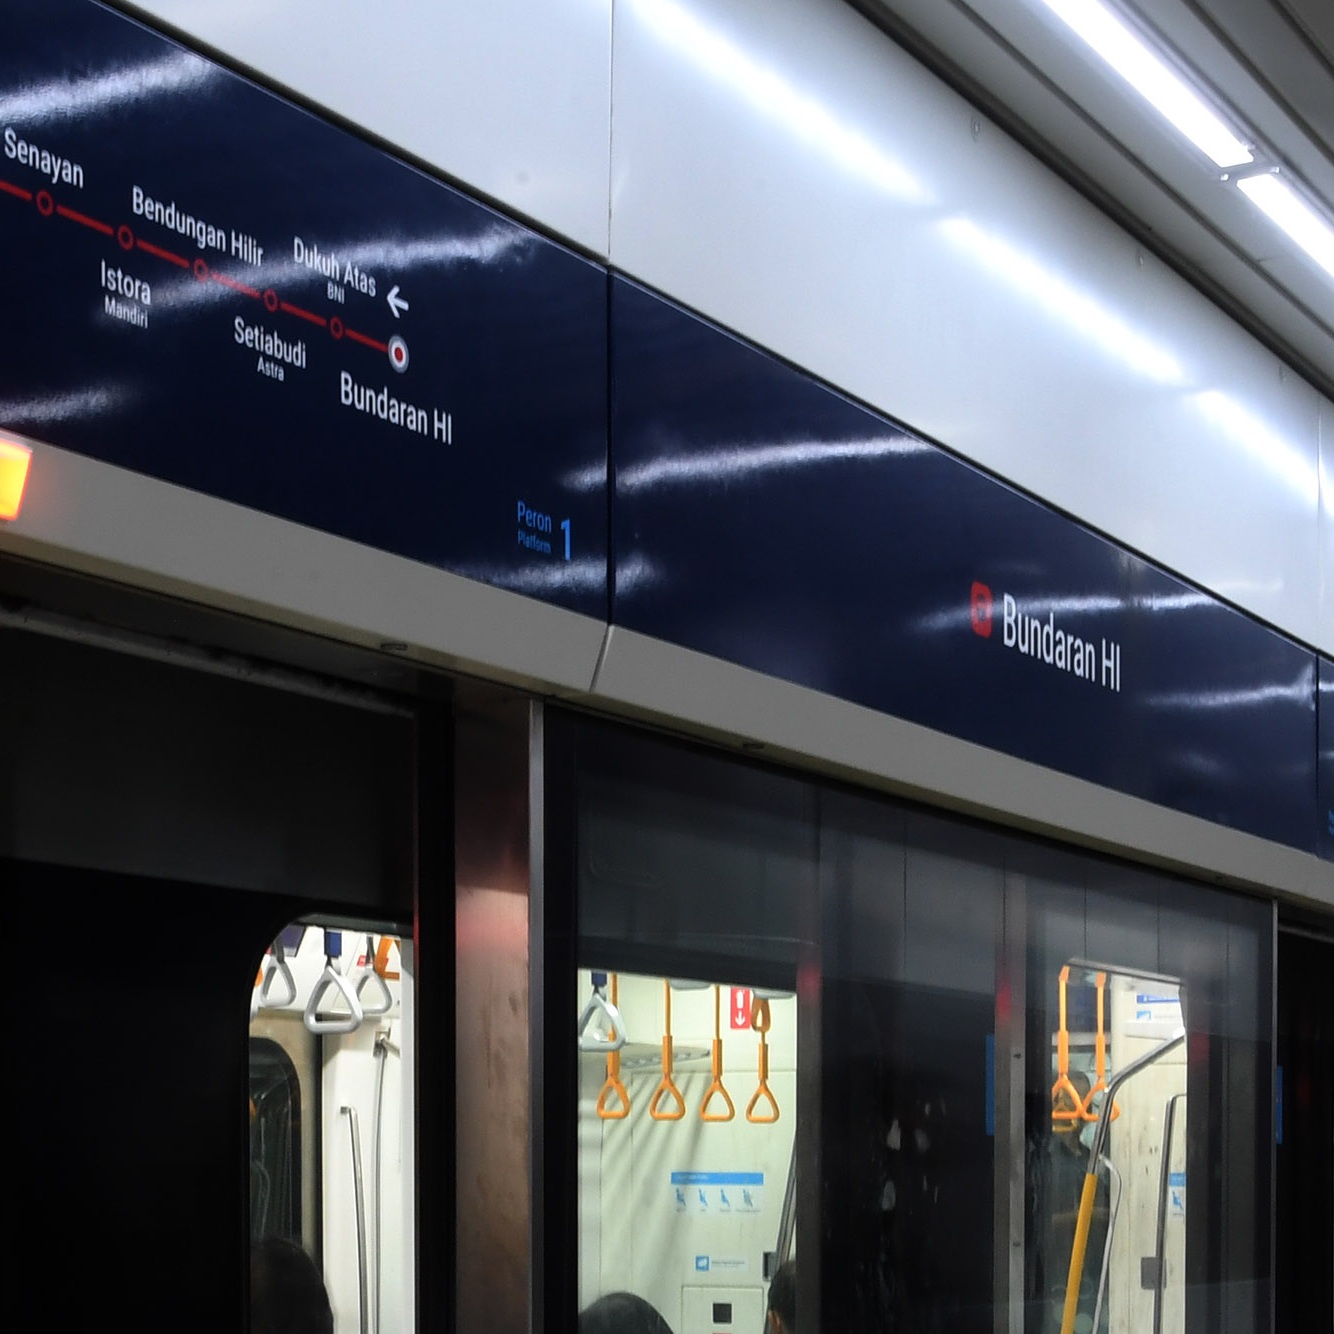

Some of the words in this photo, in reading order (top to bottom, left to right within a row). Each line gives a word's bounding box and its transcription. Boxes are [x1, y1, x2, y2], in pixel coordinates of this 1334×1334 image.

[4, 126, 84, 189] Senayan
[132, 184, 226, 252] Bendungan
[230, 229, 264, 267] Hilir
[100, 258, 151, 306] Istora
[293, 235, 340, 282] Dukuh
[343, 261, 376, 298] Atas
[326, 280, 346, 304] BNI
[103, 294, 149, 329] Mandiri
[233, 315, 307, 369] Setiabudi
[256, 355, 285, 382] Astra
[340, 370, 428, 436] Bundaran
[433, 407, 453, 446] HI
[517, 499, 552, 535] Peron
[560, 518, 571, 561] 1
[1003, 592, 1096, 682] Bundaran
[1101, 637, 1121, 693] HI
